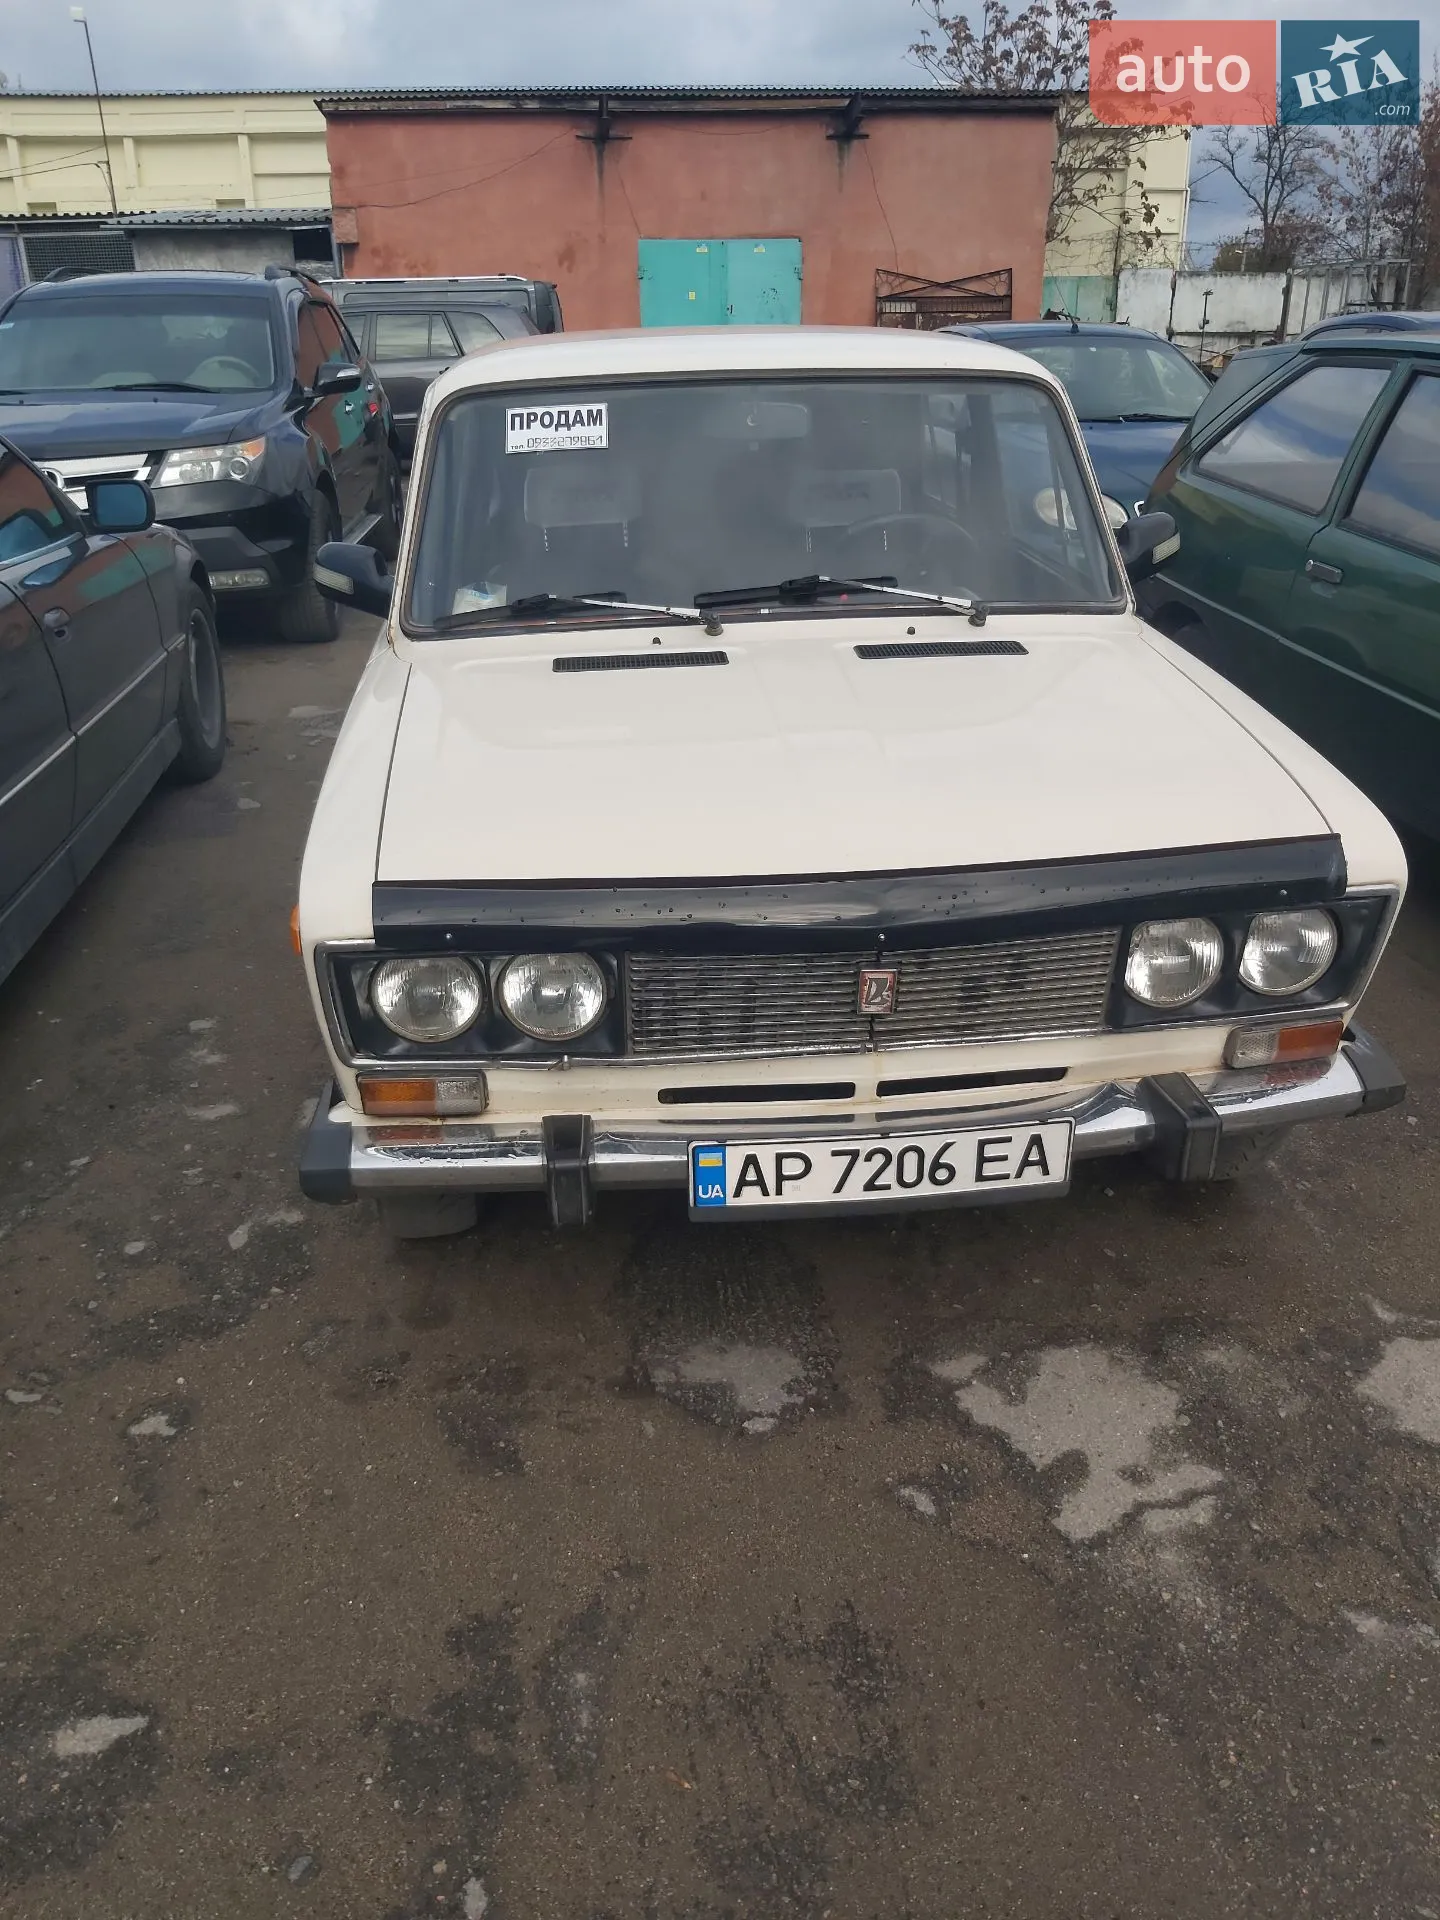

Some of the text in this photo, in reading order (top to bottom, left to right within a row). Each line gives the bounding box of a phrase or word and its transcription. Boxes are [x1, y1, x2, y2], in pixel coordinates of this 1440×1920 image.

[510, 408, 603, 432] ПРОДАМ
[732, 1133, 1050, 1198] AP 7206 EA
[698, 1184, 724, 1199] UA
